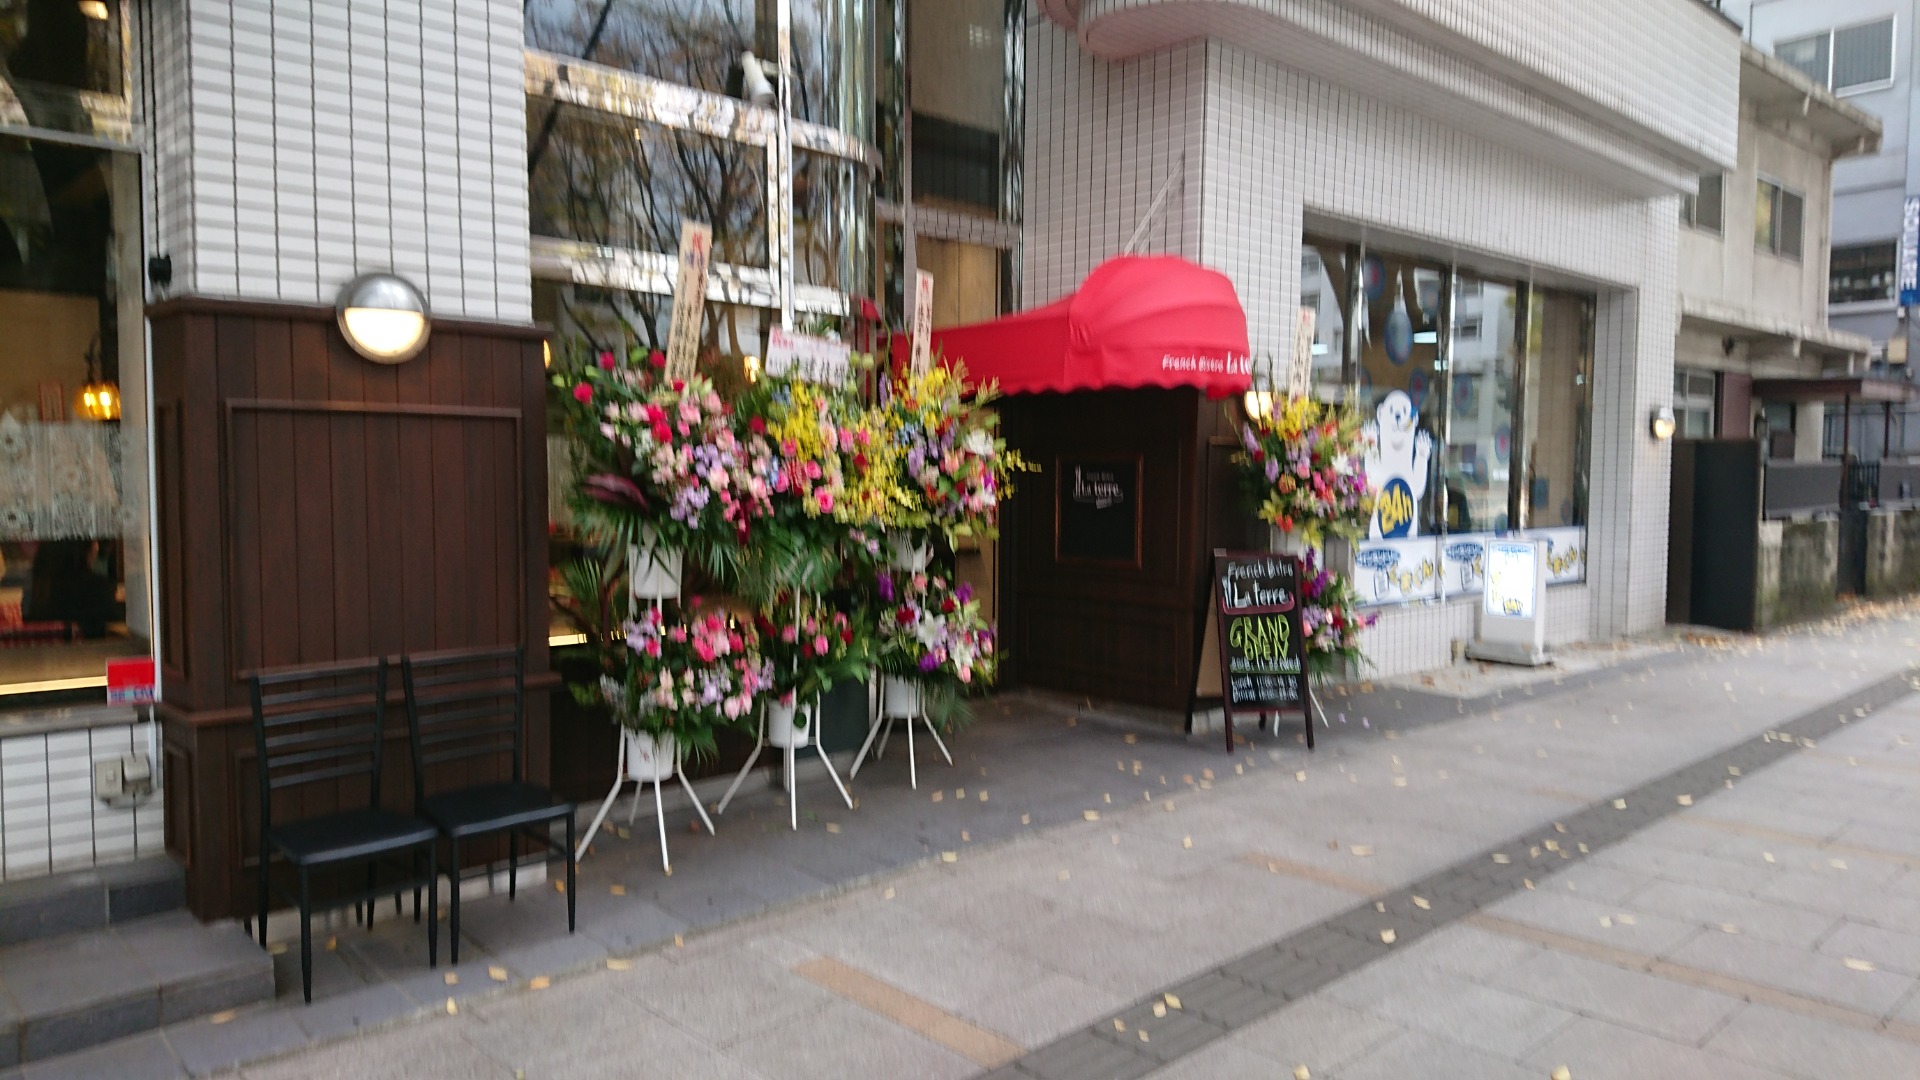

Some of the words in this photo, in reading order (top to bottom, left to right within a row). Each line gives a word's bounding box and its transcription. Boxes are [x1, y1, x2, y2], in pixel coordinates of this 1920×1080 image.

[1162, 354, 1197, 372] French
[1228, 559, 1266, 580] French
[1233, 581, 1252, 608] La
[1230, 614, 1290, 648] GRAND
[1244, 639, 1289, 663] OPEN
